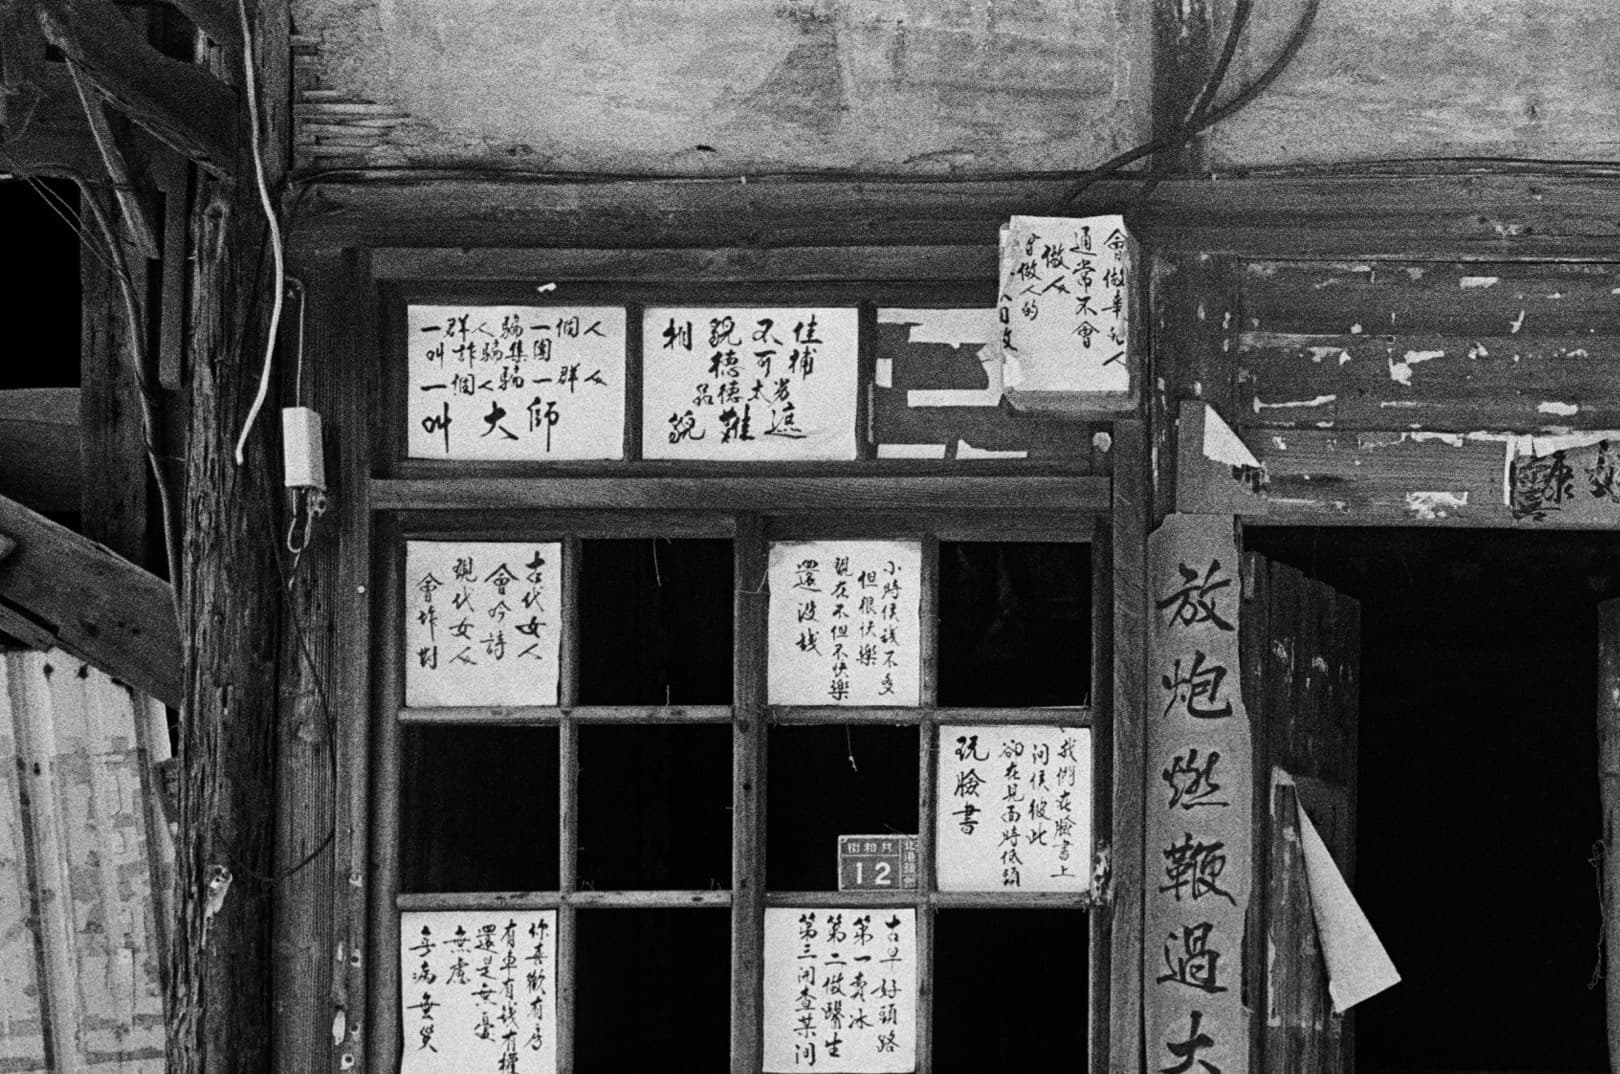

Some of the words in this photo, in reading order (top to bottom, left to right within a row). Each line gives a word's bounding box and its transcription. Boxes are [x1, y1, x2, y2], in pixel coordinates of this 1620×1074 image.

[1042, 244, 1070, 294] 做人
[1070, 226, 1100, 348] 通常不會
[420, 315, 607, 339] 一群人騙一個人
[426, 339, 552, 365] 叫詐騙集團
[662, 315, 823, 351] 相貌不佳
[709, 350, 814, 382] 德可補
[420, 363, 607, 395] 一個人騙一群人
[422, 397, 560, 453] 叫大師
[416, 573, 443, 670] 會作對
[449, 557, 477, 665] 現代女人
[480, 563, 521, 660] 會吟詩
[515, 551, 546, 660] 古代女人
[828, 557, 854, 701] 現在不但不快樂
[856, 571, 878, 666] 但很快樂
[951, 735, 989, 836] 玩臉書
[1026, 744, 1051, 847] 問候彼此
[1051, 737, 1078, 878] 我們在臉書上
[794, 912, 817, 1066] 第三開查某間
[821, 913, 847, 1058] 第二做醫生
[849, 915, 873, 1029] 第一賣冰
[871, 914, 902, 1053] 古早好頭路
